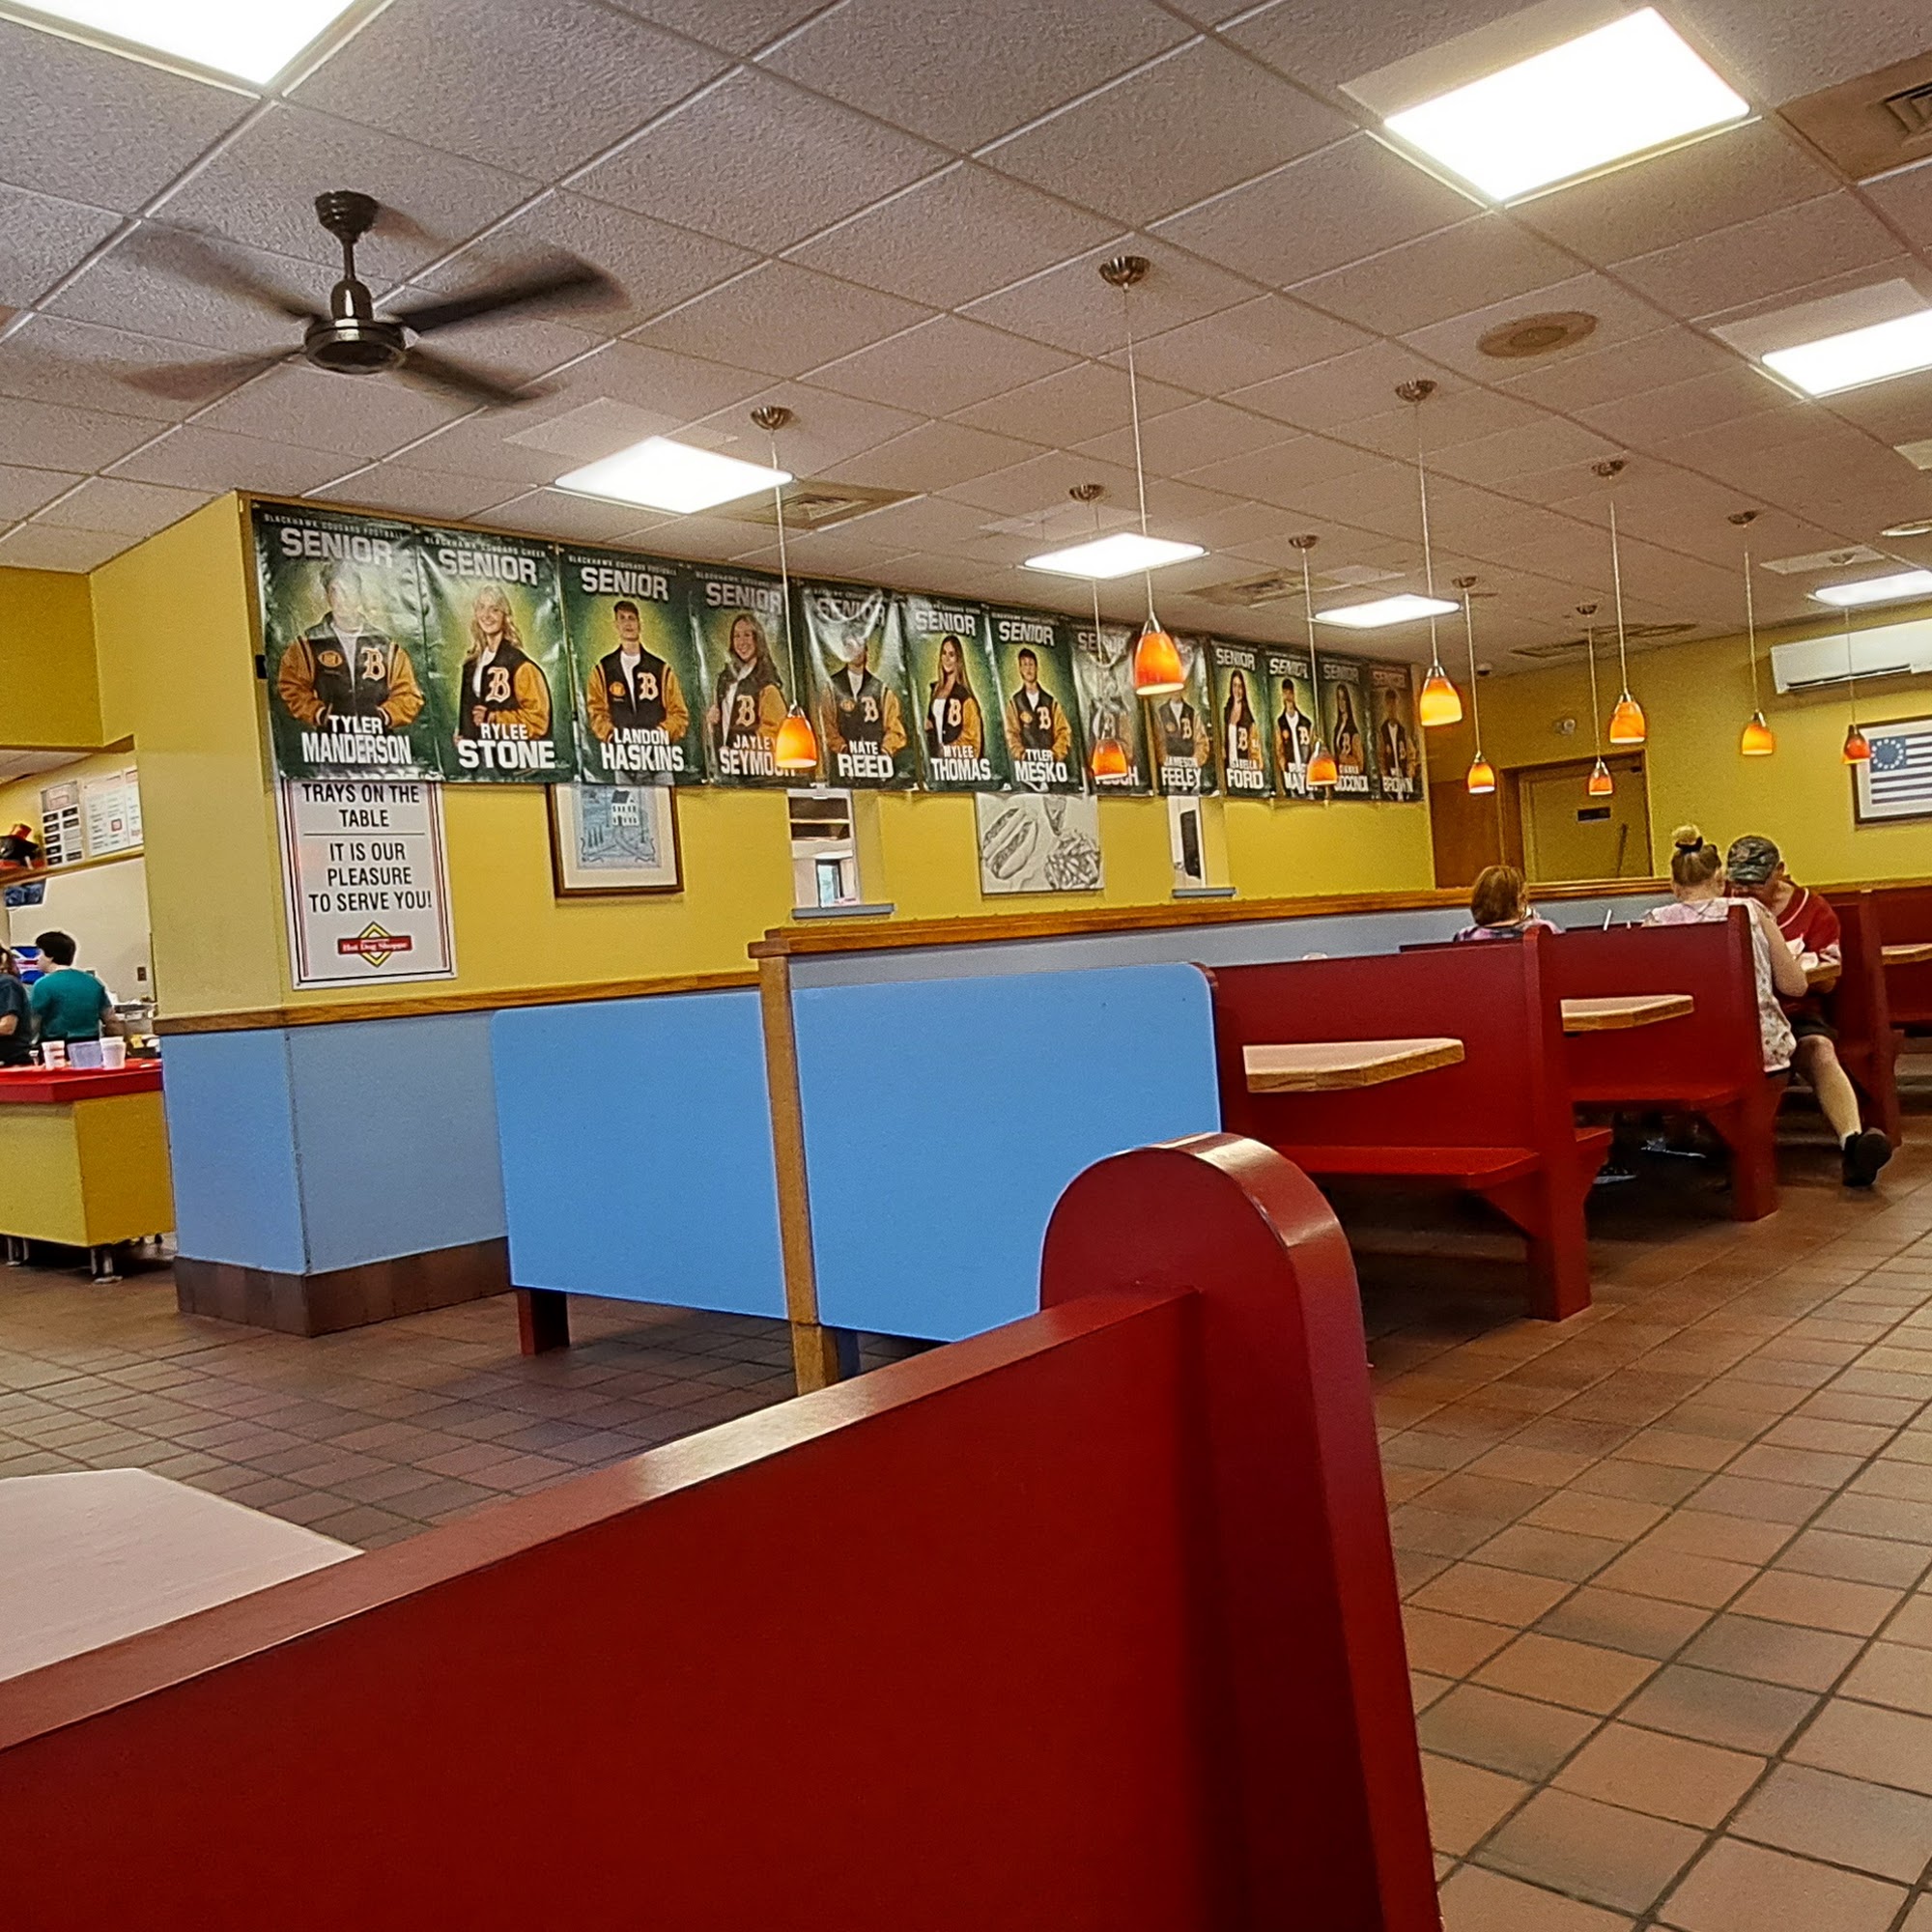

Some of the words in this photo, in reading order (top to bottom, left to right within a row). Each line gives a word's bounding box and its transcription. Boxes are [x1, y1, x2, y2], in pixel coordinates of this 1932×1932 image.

[264, 513, 318, 528] BLACKHAWK
[280, 527, 392, 568] SENIOR
[438, 548, 538, 586] SENIOR
[581, 567, 668, 601] SENIOR
[706, 582, 782, 616] SENIOR
[915, 611, 976, 637] SENIOR
[999, 621, 1055, 646] SENIOR
[360, 646, 386, 681] B
[1215, 648, 1255, 670] SENIOR
[1269, 658, 1308, 679] SENIOR
[486, 667, 511, 702] B
[638, 672, 659, 700] B
[737, 695, 755, 726] B
[861, 696, 879, 723] B
[948, 698, 962, 726] B
[1037, 707, 1052, 729] B
[327, 714, 383, 734] TYLER
[480, 723, 528, 740] RYLEE
[613, 727, 669, 745] LANDON
[849, 740, 879, 755] NATE
[301, 732, 412, 764] MANDERSON
[458, 739, 556, 769] STONE
[600, 742, 685, 772] HASKINS
[943, 745, 974, 758] MYLEE
[1025, 749, 1053, 762] TYLER
[720, 749, 796, 777] SEYMO
[838, 753, 895, 779] REED
[930, 757, 991, 781] THOMAS
[1014, 760, 1067, 782] MESKO
[1161, 767, 1202, 788] FEELEY
[1227, 768, 1264, 789] FORD
[302, 783, 355, 803] TRAYS
[361, 783, 384, 803] ON
[388, 784, 420, 803] THE
[339, 810, 389, 827] TABLE
[329, 842, 344, 862] IT
[351, 843, 366, 861] IS
[371, 842, 406, 861] OUR
[327, 867, 412, 887] PLEASURE
[309, 894, 330, 913] TO
[337, 892, 389, 911] SERVE
[394, 891, 432, 909] YOU!
